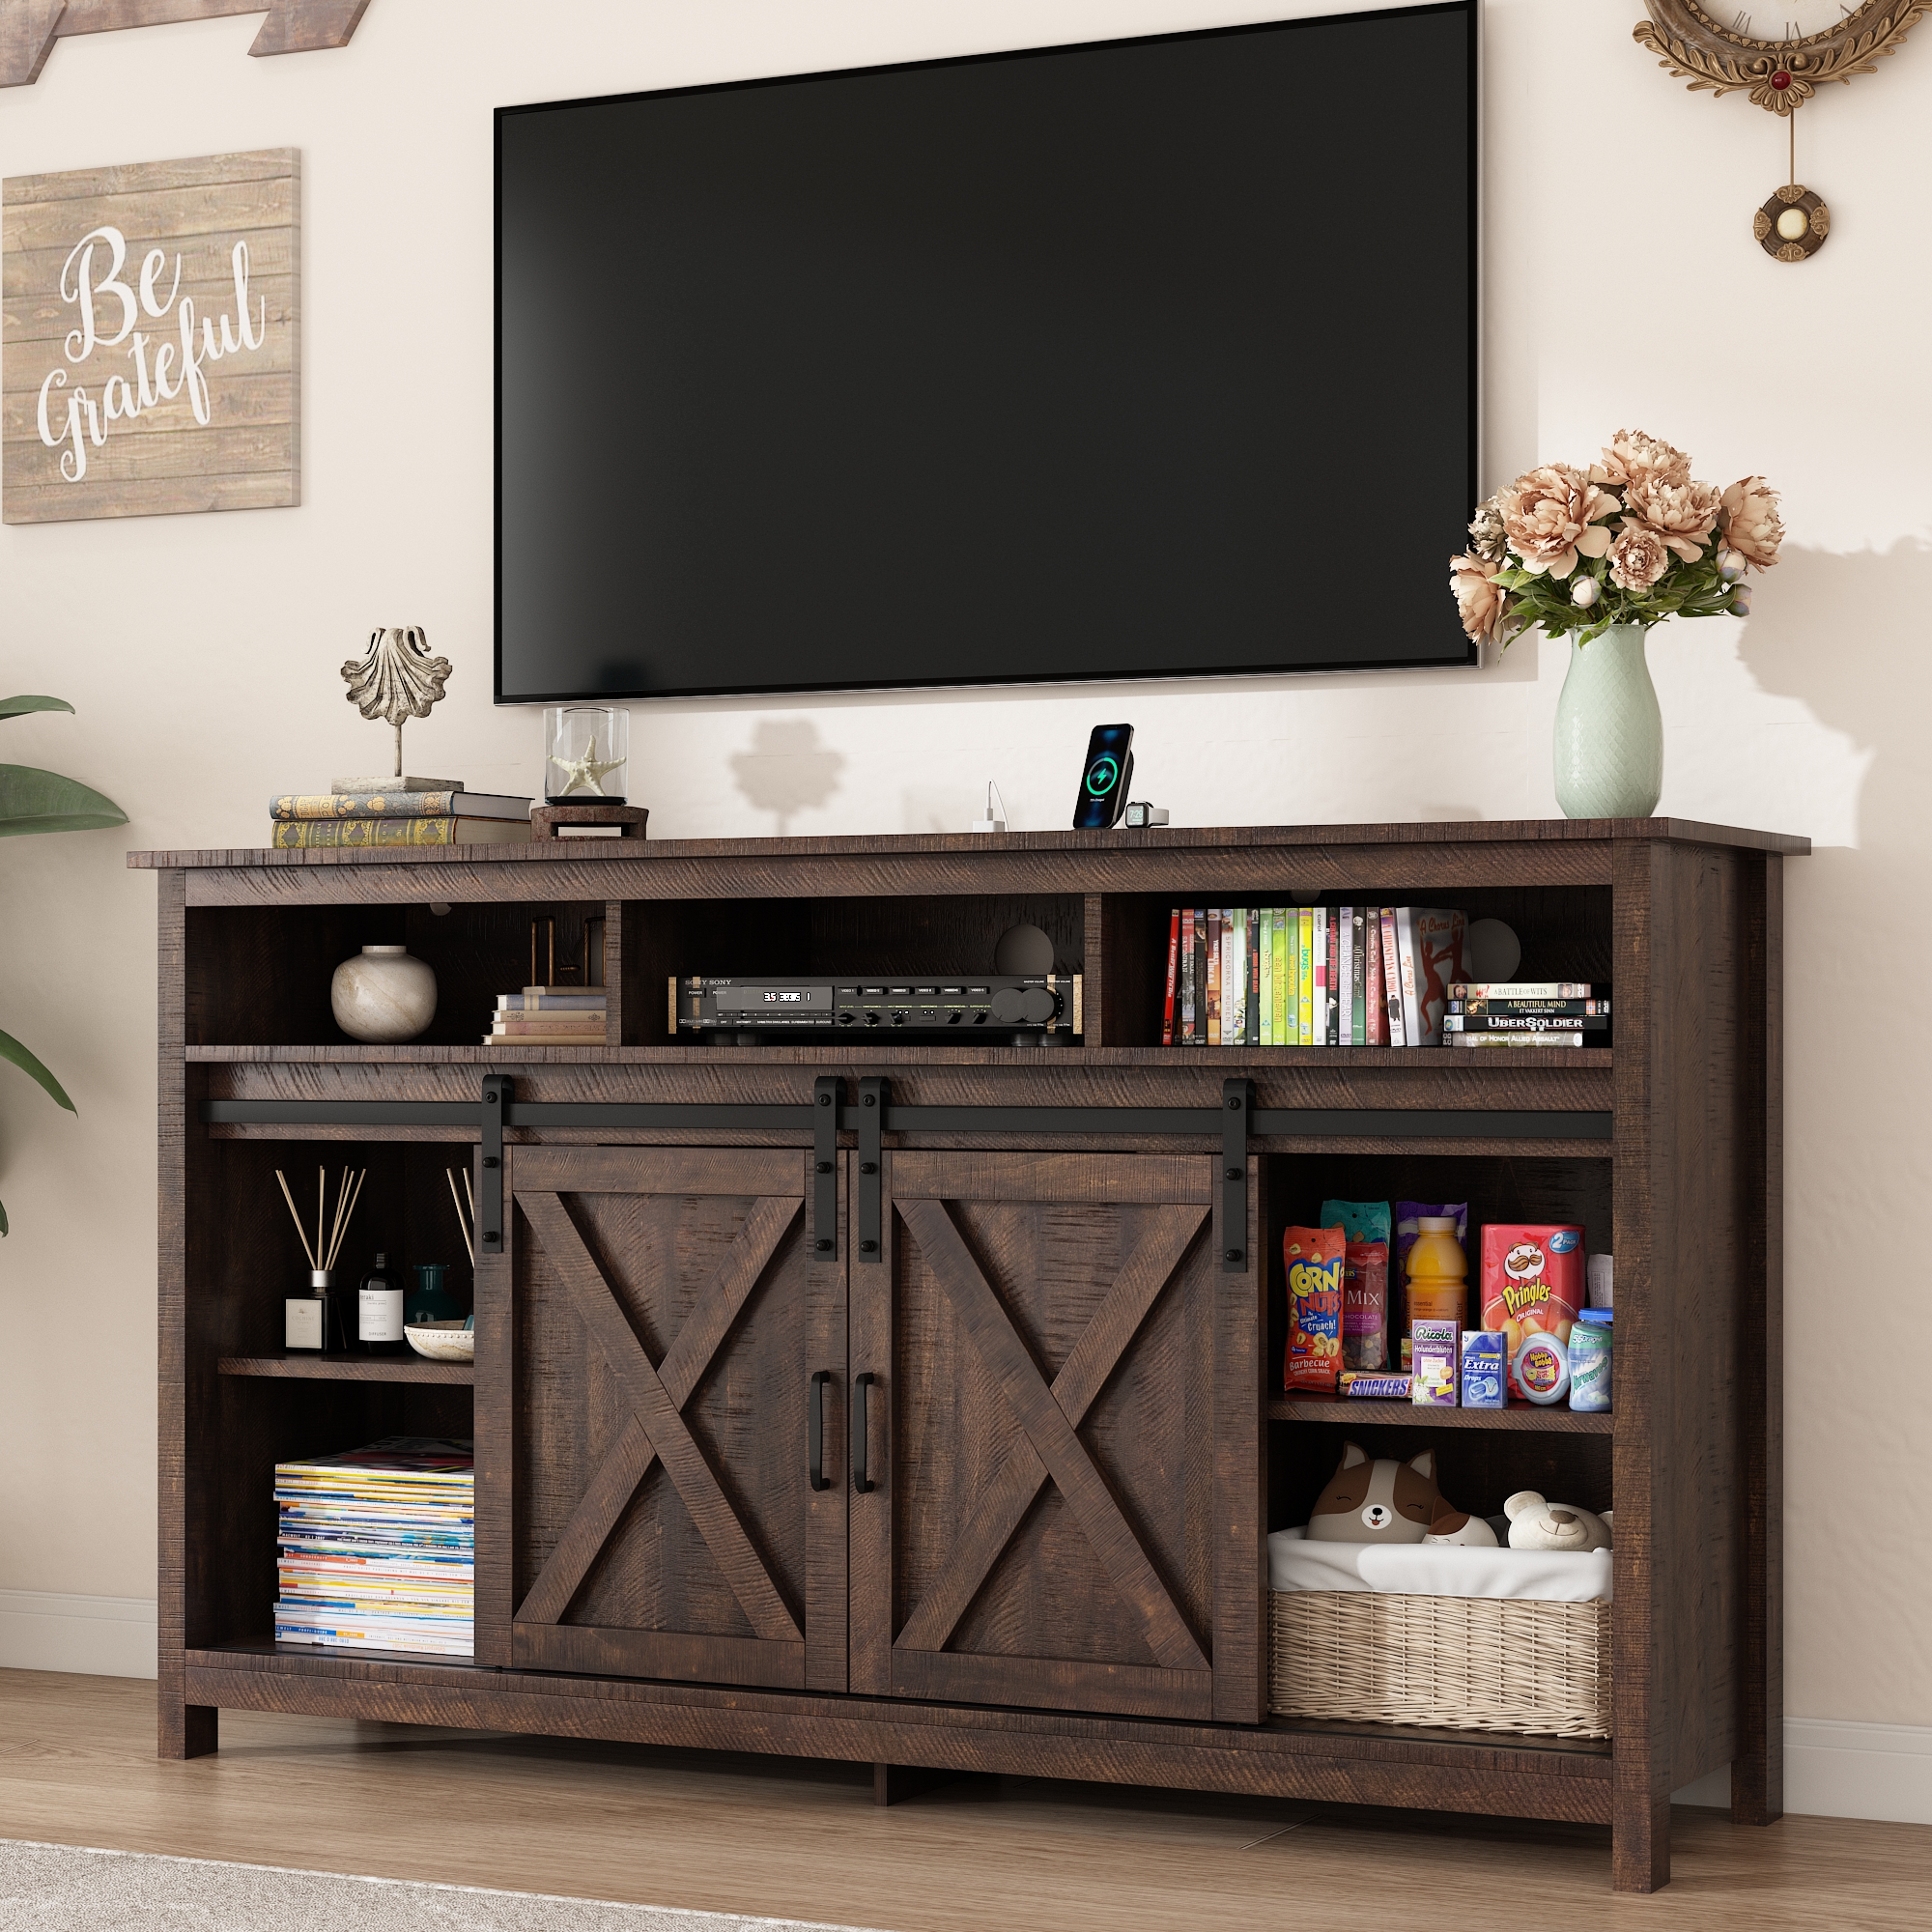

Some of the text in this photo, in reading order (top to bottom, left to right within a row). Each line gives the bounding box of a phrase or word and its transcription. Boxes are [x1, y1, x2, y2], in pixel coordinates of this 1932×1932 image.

[60, 226, 182, 363] Be
[37, 240, 267, 482] Grateful
[321, 796, 332, 817] POE
[1429, 917, 1450, 932] Chorus
[1451, 912, 1465, 930] Line
[1341, 939, 1352, 978] CHANGE
[1382, 930, 1395, 970] CHRISTMAS
[1353, 949, 1364, 981] Christmas
[1403, 955, 1413, 968] Line
[1343, 980, 1350, 989] OF
[1386, 972, 1397, 993] CAROL
[1404, 970, 1413, 988] Chorus
[1498, 987, 1523, 996] BATTLE
[1530, 987, 1548, 996] WITS
[1341, 992, 1352, 1022] HEART
[1513, 1000, 1546, 1009] BEAUTIFUL
[1547, 1000, 1566, 1009] MIND
[1551, 1233, 1564, 1248] 2
[1290, 1262, 1341, 1297] CORN
[1299, 1291, 1341, 1317] NUTS
[1502, 1277, 1552, 1318] Pringles
[1517, 1308, 1544, 1322] ORIGINAL
[1307, 1320, 1336, 1331] Crunch!
[1415, 1325, 1453, 1341] Ricola
[1414, 1344, 1453, 1353] Holunderblüten
[1290, 1359, 1330, 1371] Barbecue
[1463, 1359, 1500, 1371] Extra
[1349, 1378, 1409, 1396] SNICKERS
